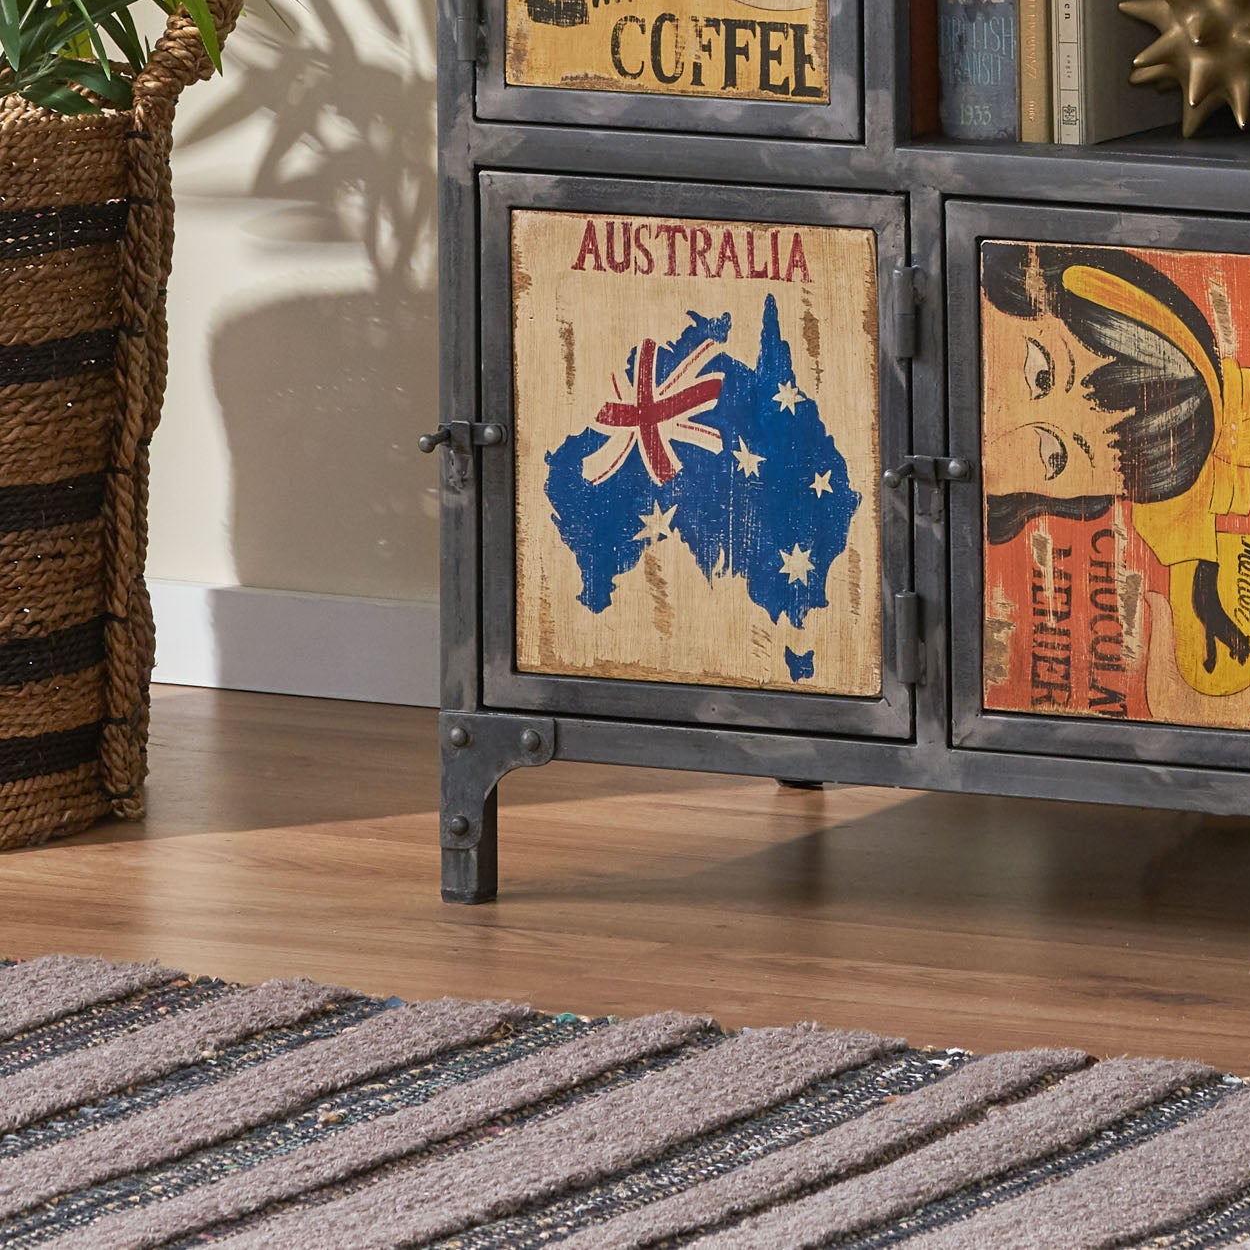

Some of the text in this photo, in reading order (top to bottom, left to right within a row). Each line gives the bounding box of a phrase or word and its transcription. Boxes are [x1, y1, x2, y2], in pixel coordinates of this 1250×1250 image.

[611, 12, 824, 97] COFFEE
[939, 14, 1015, 60] BRITISH
[570, 220, 815, 284] AUSTRALIA
[1031, 545, 1073, 708] MENIER
